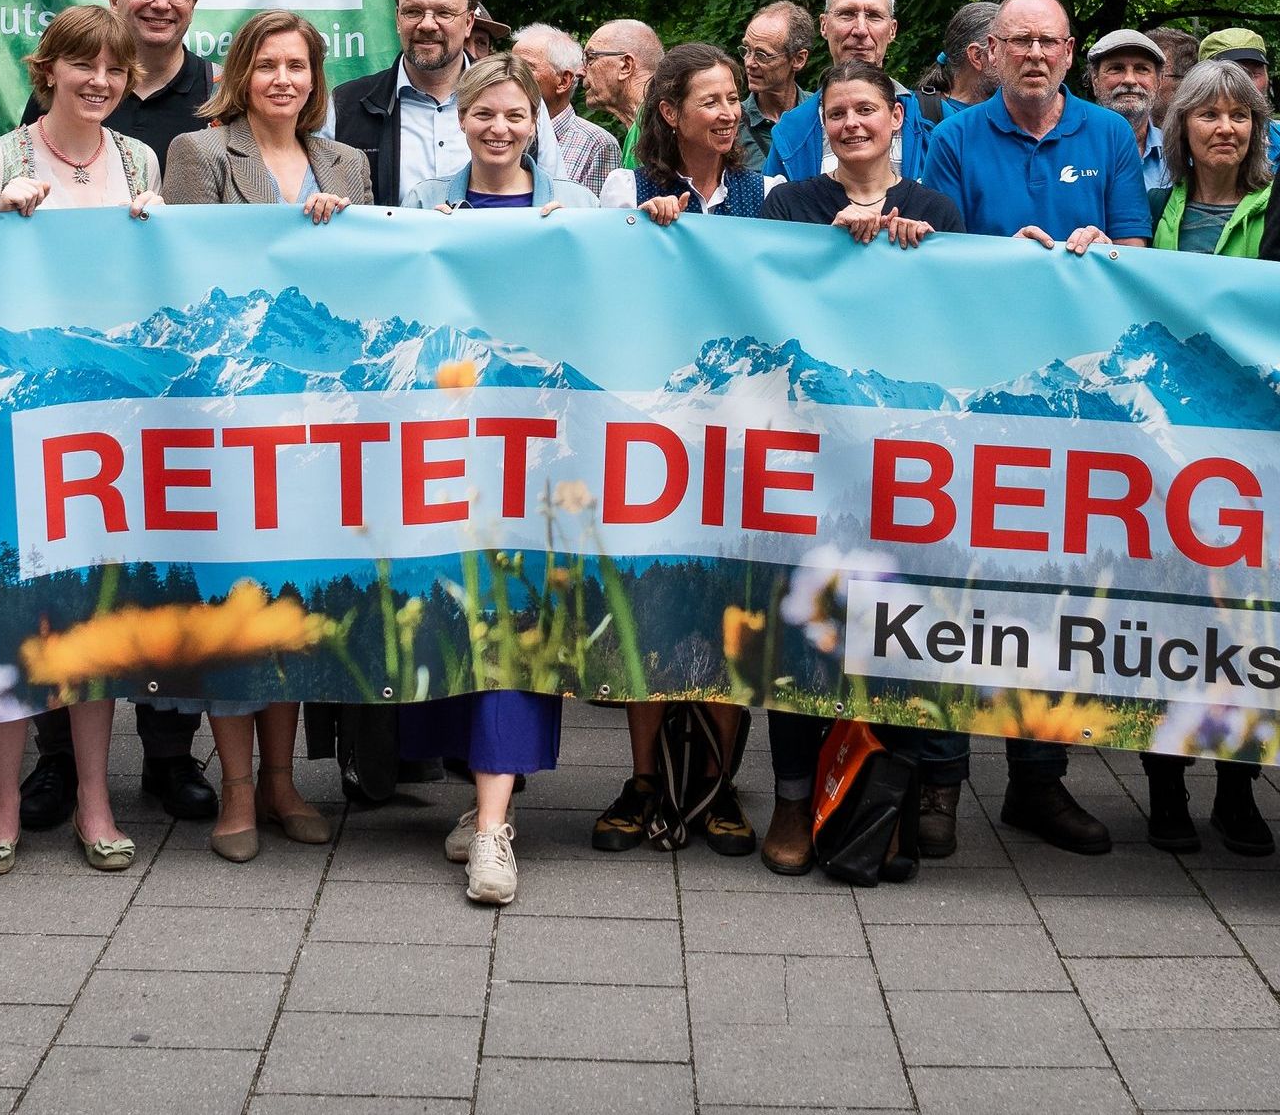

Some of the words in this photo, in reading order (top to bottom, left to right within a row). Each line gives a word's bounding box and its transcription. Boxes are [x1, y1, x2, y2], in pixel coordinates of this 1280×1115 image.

[1080, 169, 1099, 177] LBV
[42, 417, 558, 542] RETTET
[602, 422, 820, 536] DIE
[872, 601, 1029, 669] Kein
